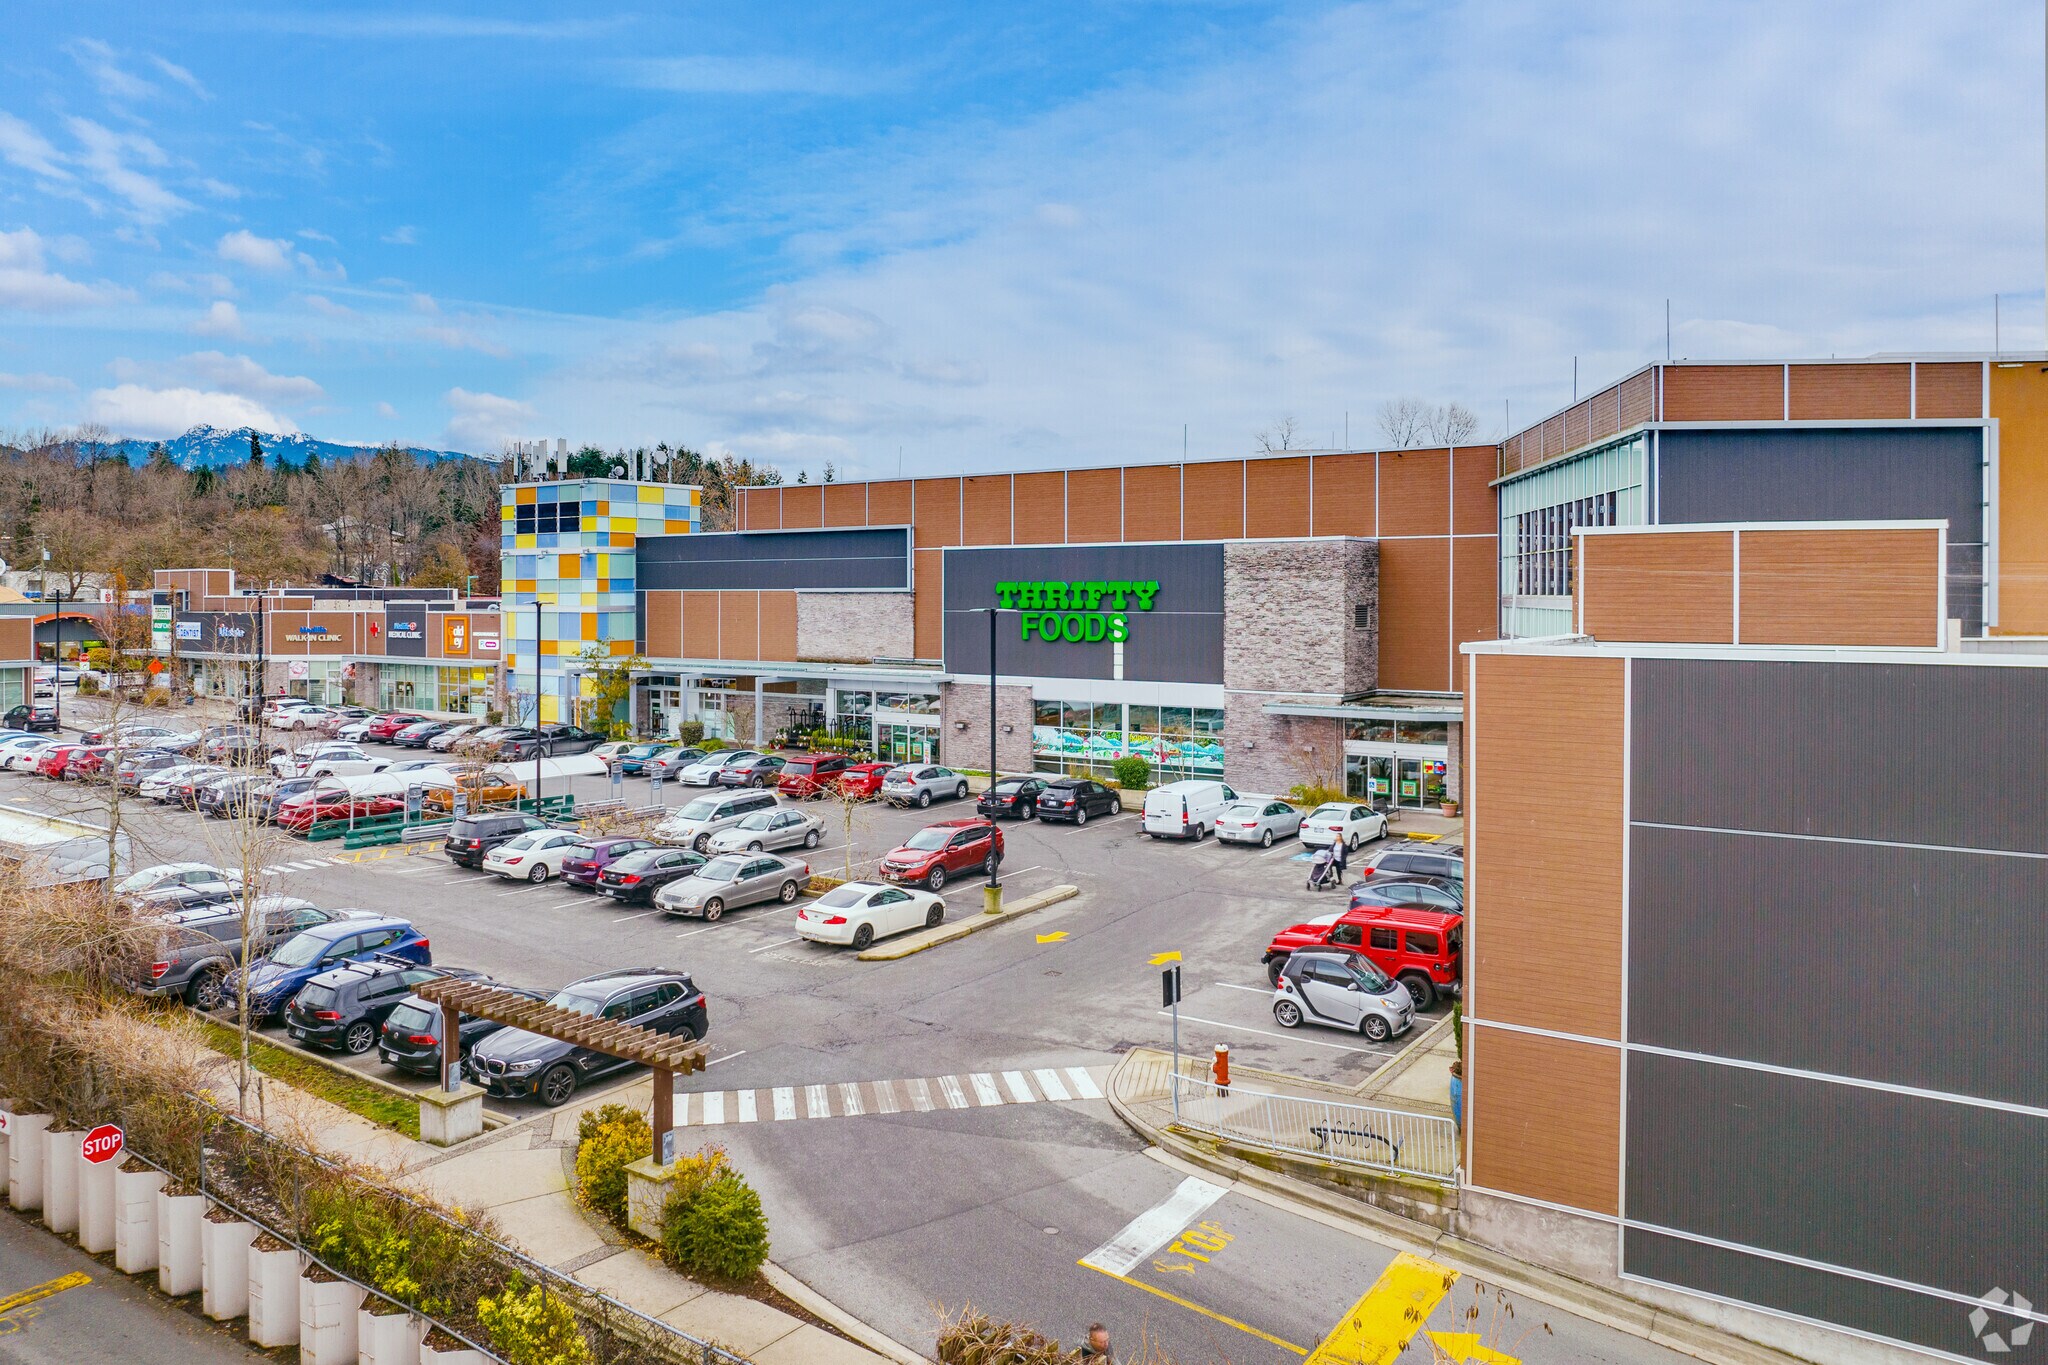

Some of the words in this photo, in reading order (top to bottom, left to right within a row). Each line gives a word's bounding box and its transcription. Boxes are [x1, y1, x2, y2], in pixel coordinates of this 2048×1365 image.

[995, 581, 1160, 610] THRIFTY
[285, 634, 317, 642] WALK-IN
[318, 634, 342, 642] CLINIC
[1021, 612, 1129, 643] FOODS
[84, 1133, 121, 1155] STOP
